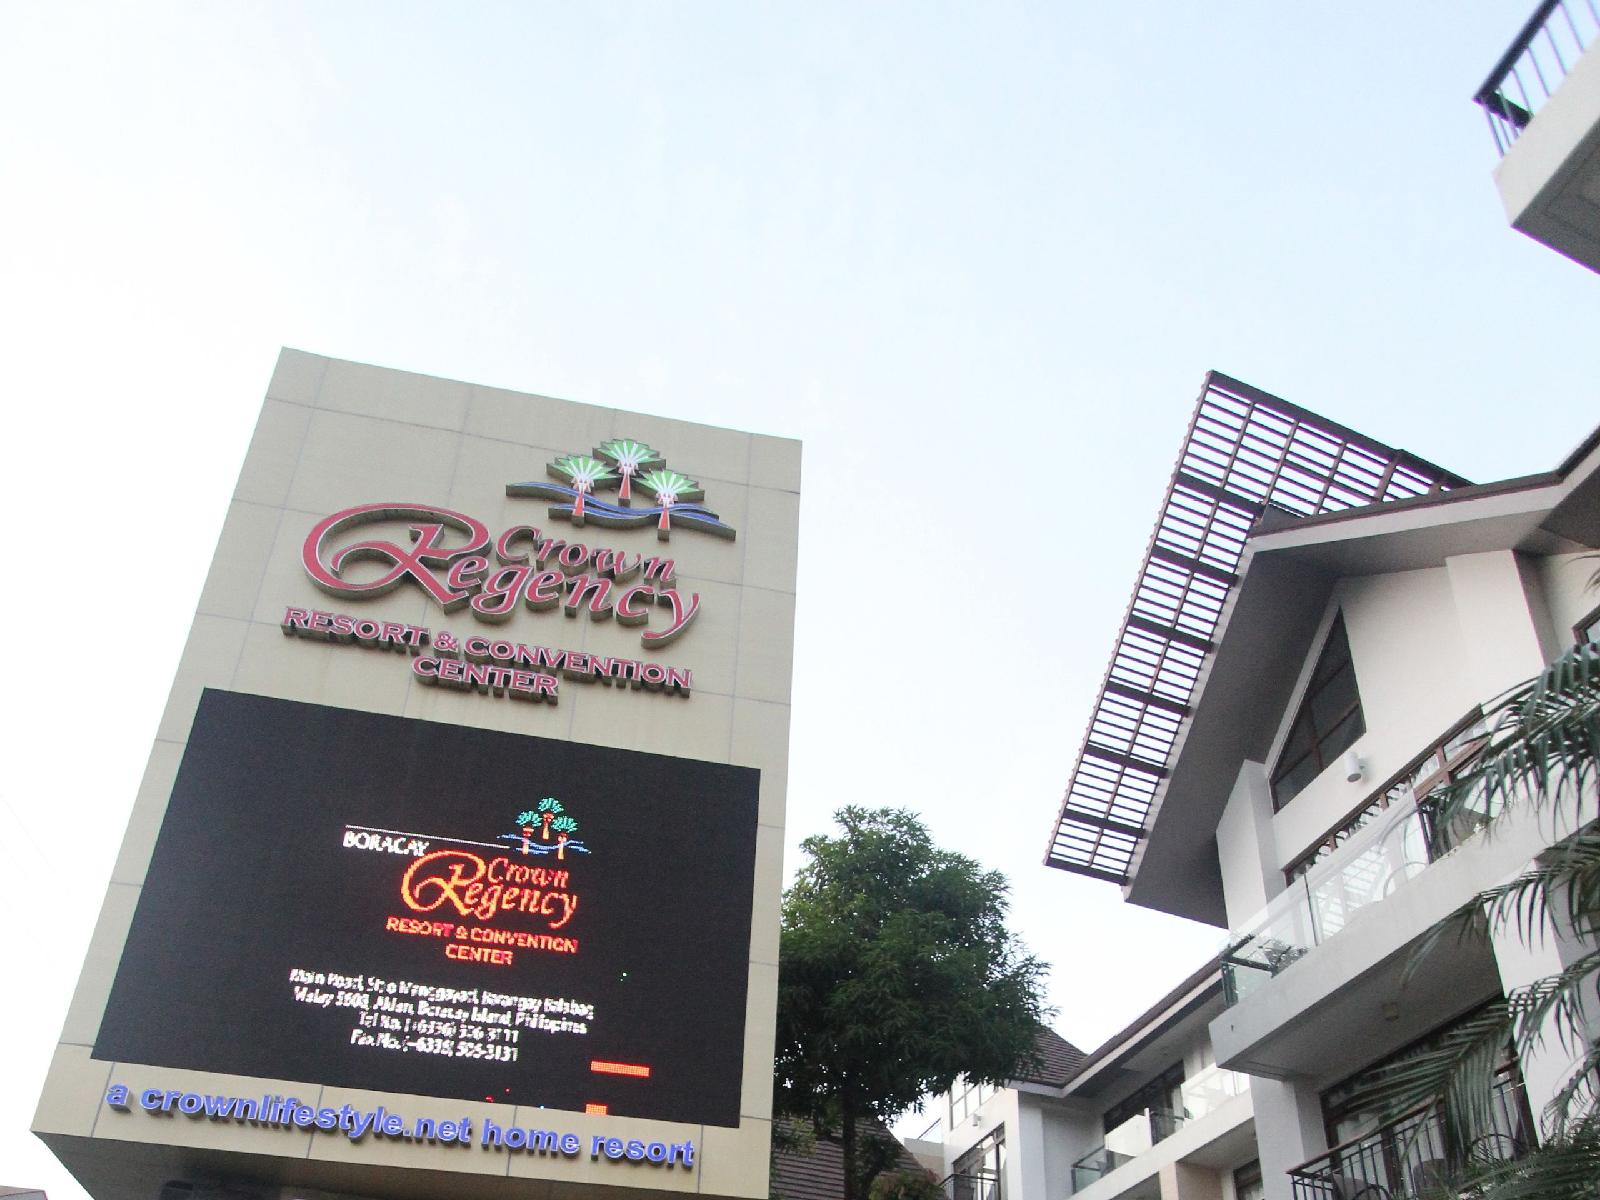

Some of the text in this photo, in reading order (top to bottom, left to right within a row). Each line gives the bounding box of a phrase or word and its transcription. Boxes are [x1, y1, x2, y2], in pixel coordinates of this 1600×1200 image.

[302, 502, 700, 650] Regency
[496, 525, 676, 585] Crown
[282, 606, 693, 695] RESORT & CONVENTION
[411, 655, 559, 703] CENTER
[342, 830, 430, 857] BORACAY
[401, 850, 578, 929] Regency
[488, 857, 570, 889] Crown
[385, 916, 578, 953] RESORT & CONVENTION
[445, 944, 513, 965] CENTER
[105, 1083, 695, 1167] a crownlifestyle.net home resort
